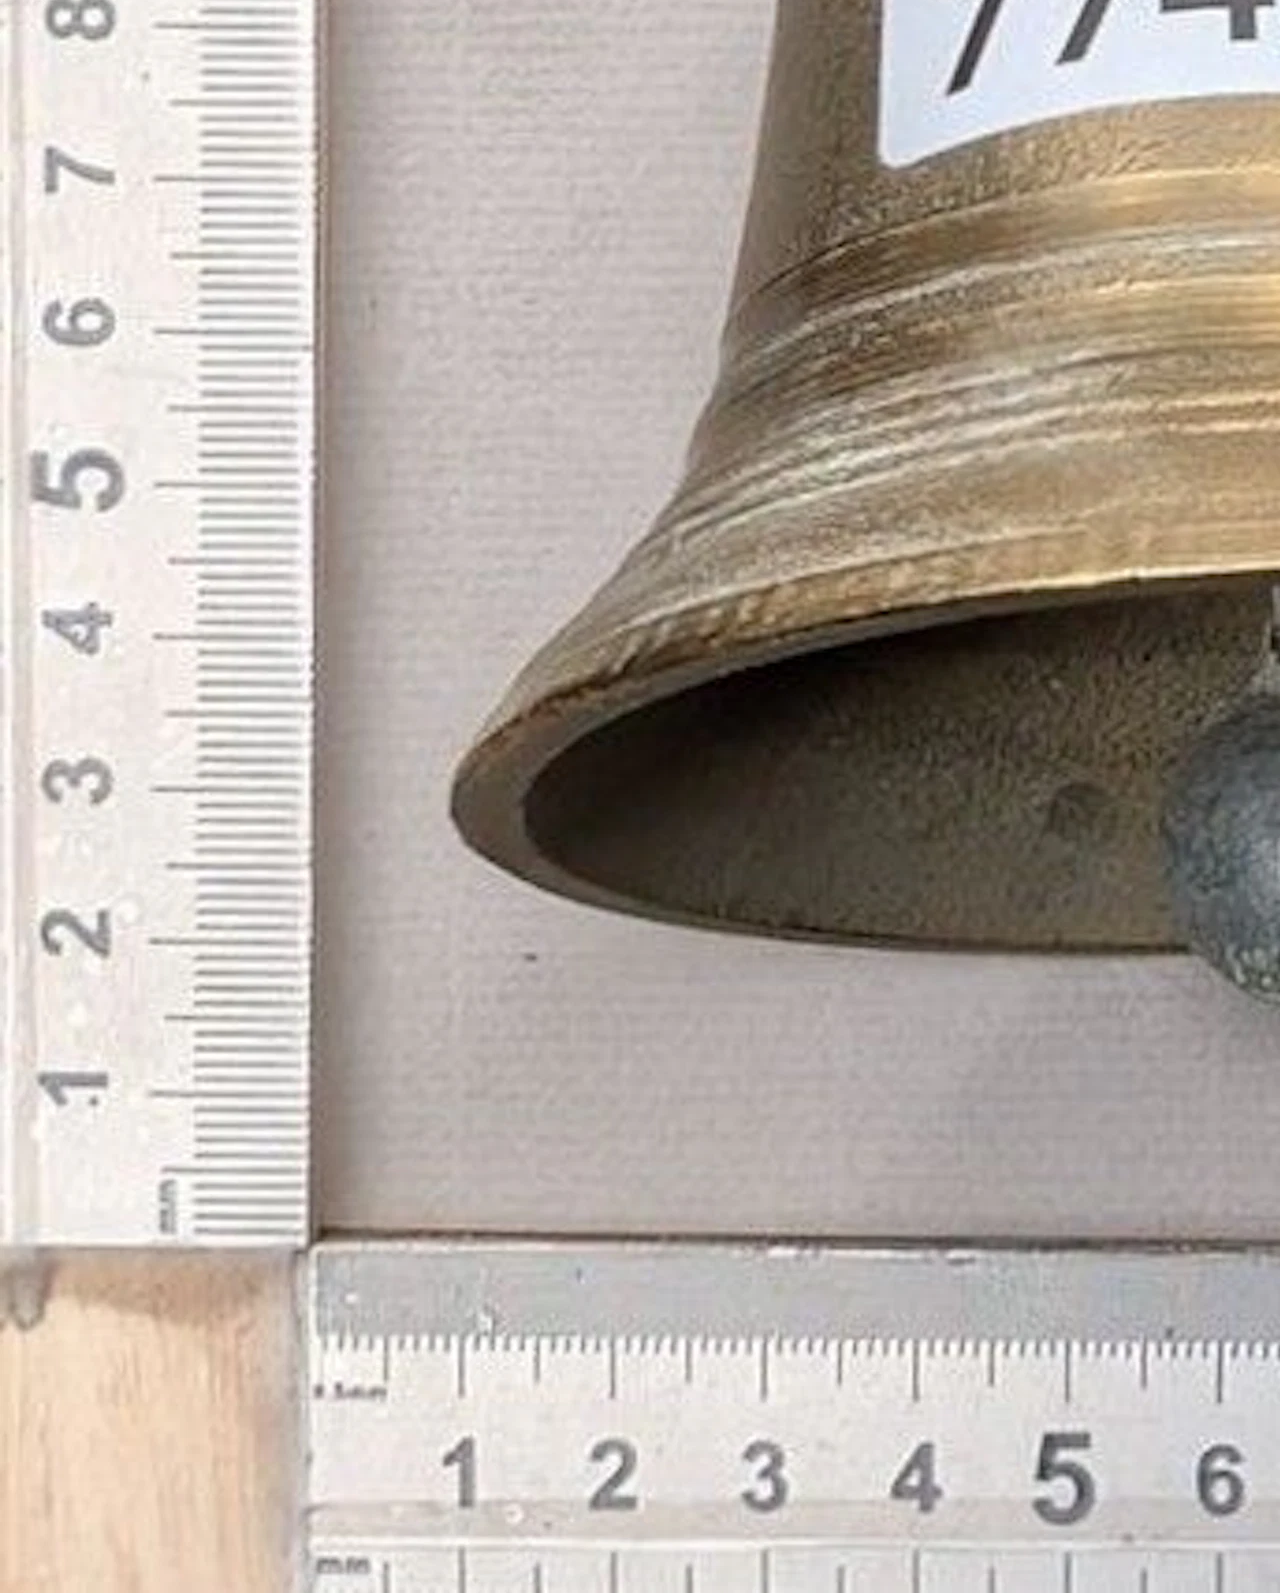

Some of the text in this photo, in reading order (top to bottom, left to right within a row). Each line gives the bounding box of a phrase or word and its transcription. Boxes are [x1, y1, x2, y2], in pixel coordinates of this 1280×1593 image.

[43, 145, 117, 196] 7
[41, 296, 117, 349] 6
[29, 447, 126, 514] 5
[41, 600, 114, 657] 4
[40, 756, 115, 807] 3
[38, 908, 113, 960] 2
[35, 1071, 110, 1108] 1
[441, 1435, 477, 1511] 1
[586, 1437, 639, 1513] 2
[739, 1439, 789, 1516] 3
[889, 1440, 944, 1516] 4
[1030, 1430, 1097, 1528] 5
[1195, 1442, 1246, 1519] 6
